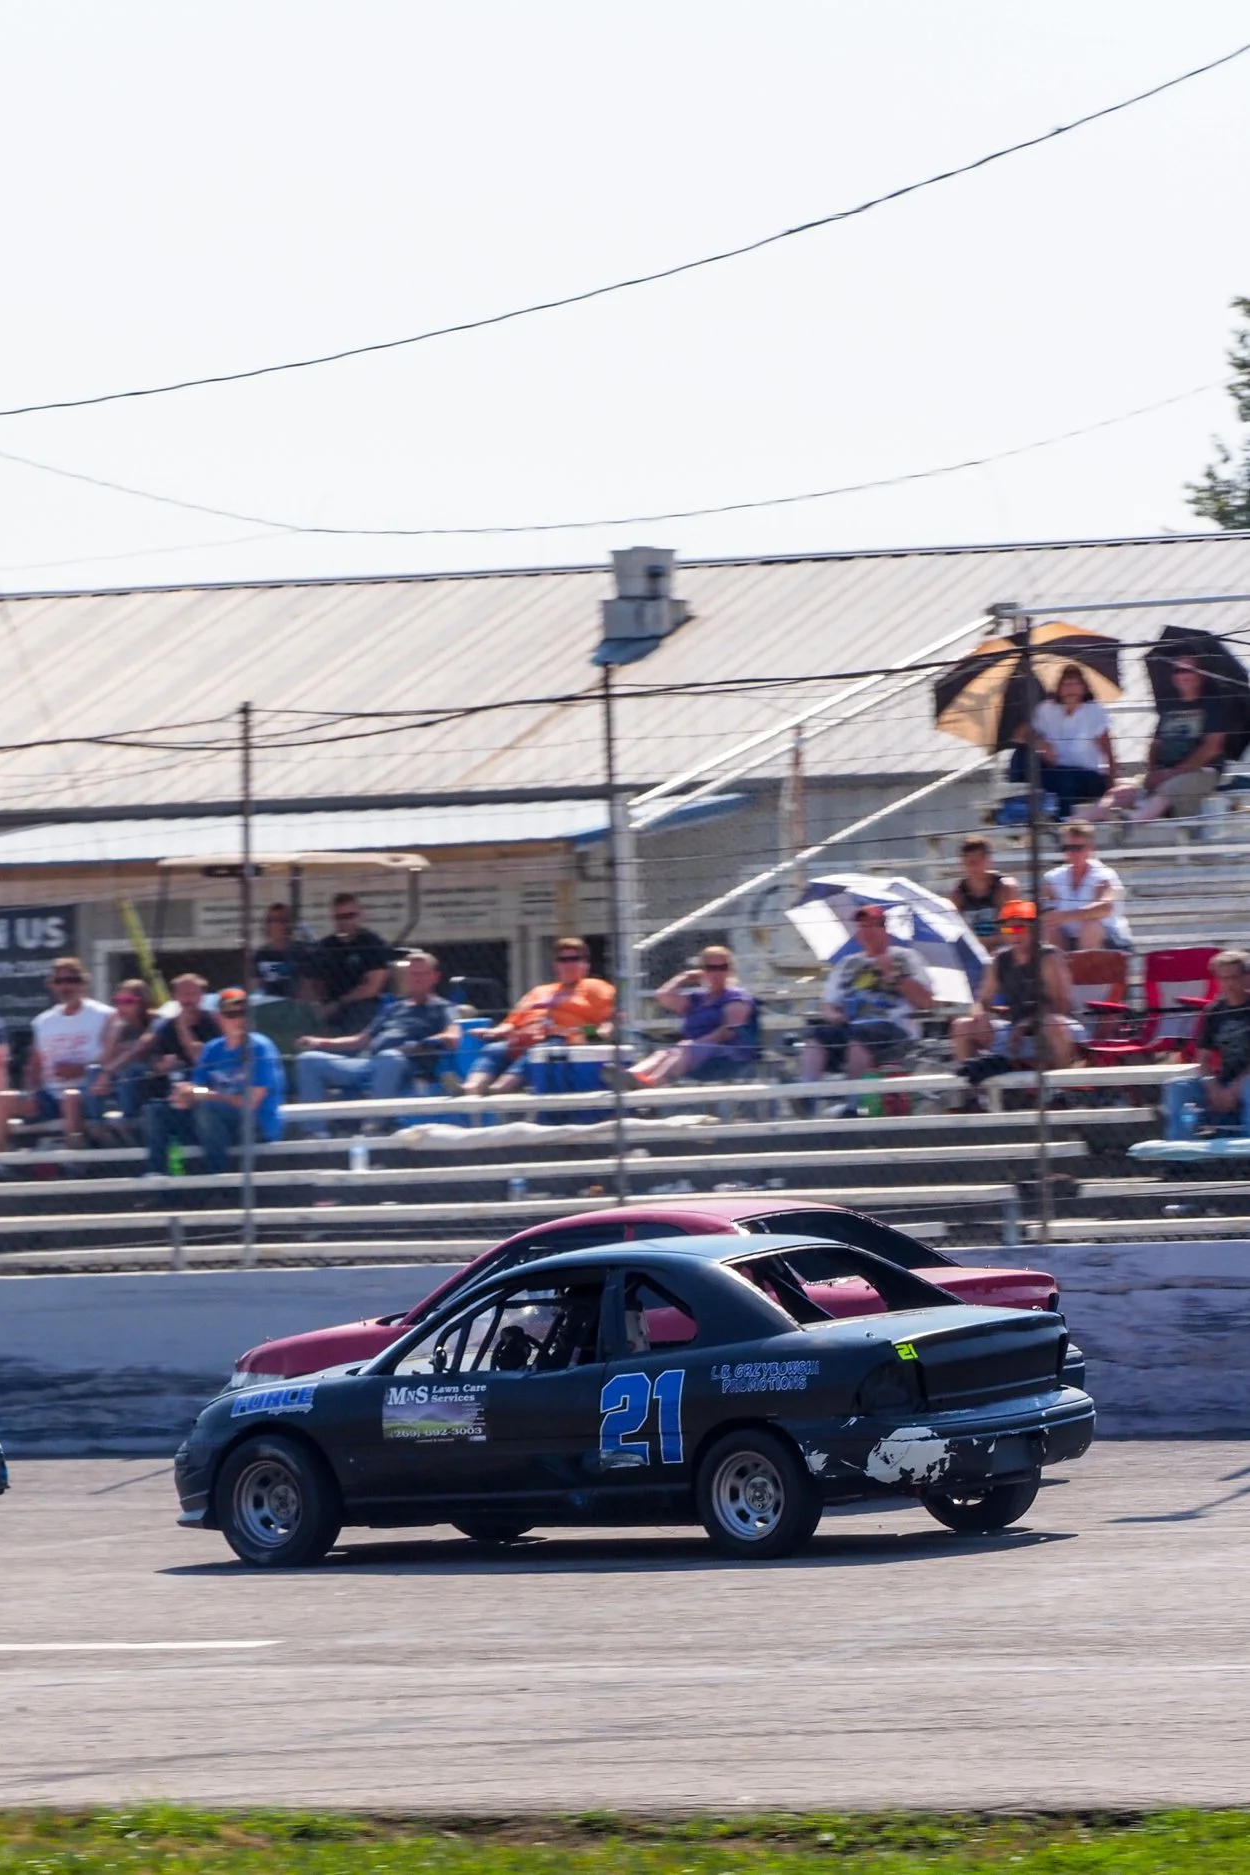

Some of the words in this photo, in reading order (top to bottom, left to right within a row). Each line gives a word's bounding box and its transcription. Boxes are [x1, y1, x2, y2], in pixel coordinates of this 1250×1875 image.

[15, 916, 66, 949] US
[895, 1344, 918, 1360] 21
[231, 1383, 318, 1417] FORCE
[431, 1394, 475, 1403] Services
[432, 1385, 459, 1394] Lawn
[462, 1384, 487, 1392] Care
[599, 1368, 686, 1469] 21
